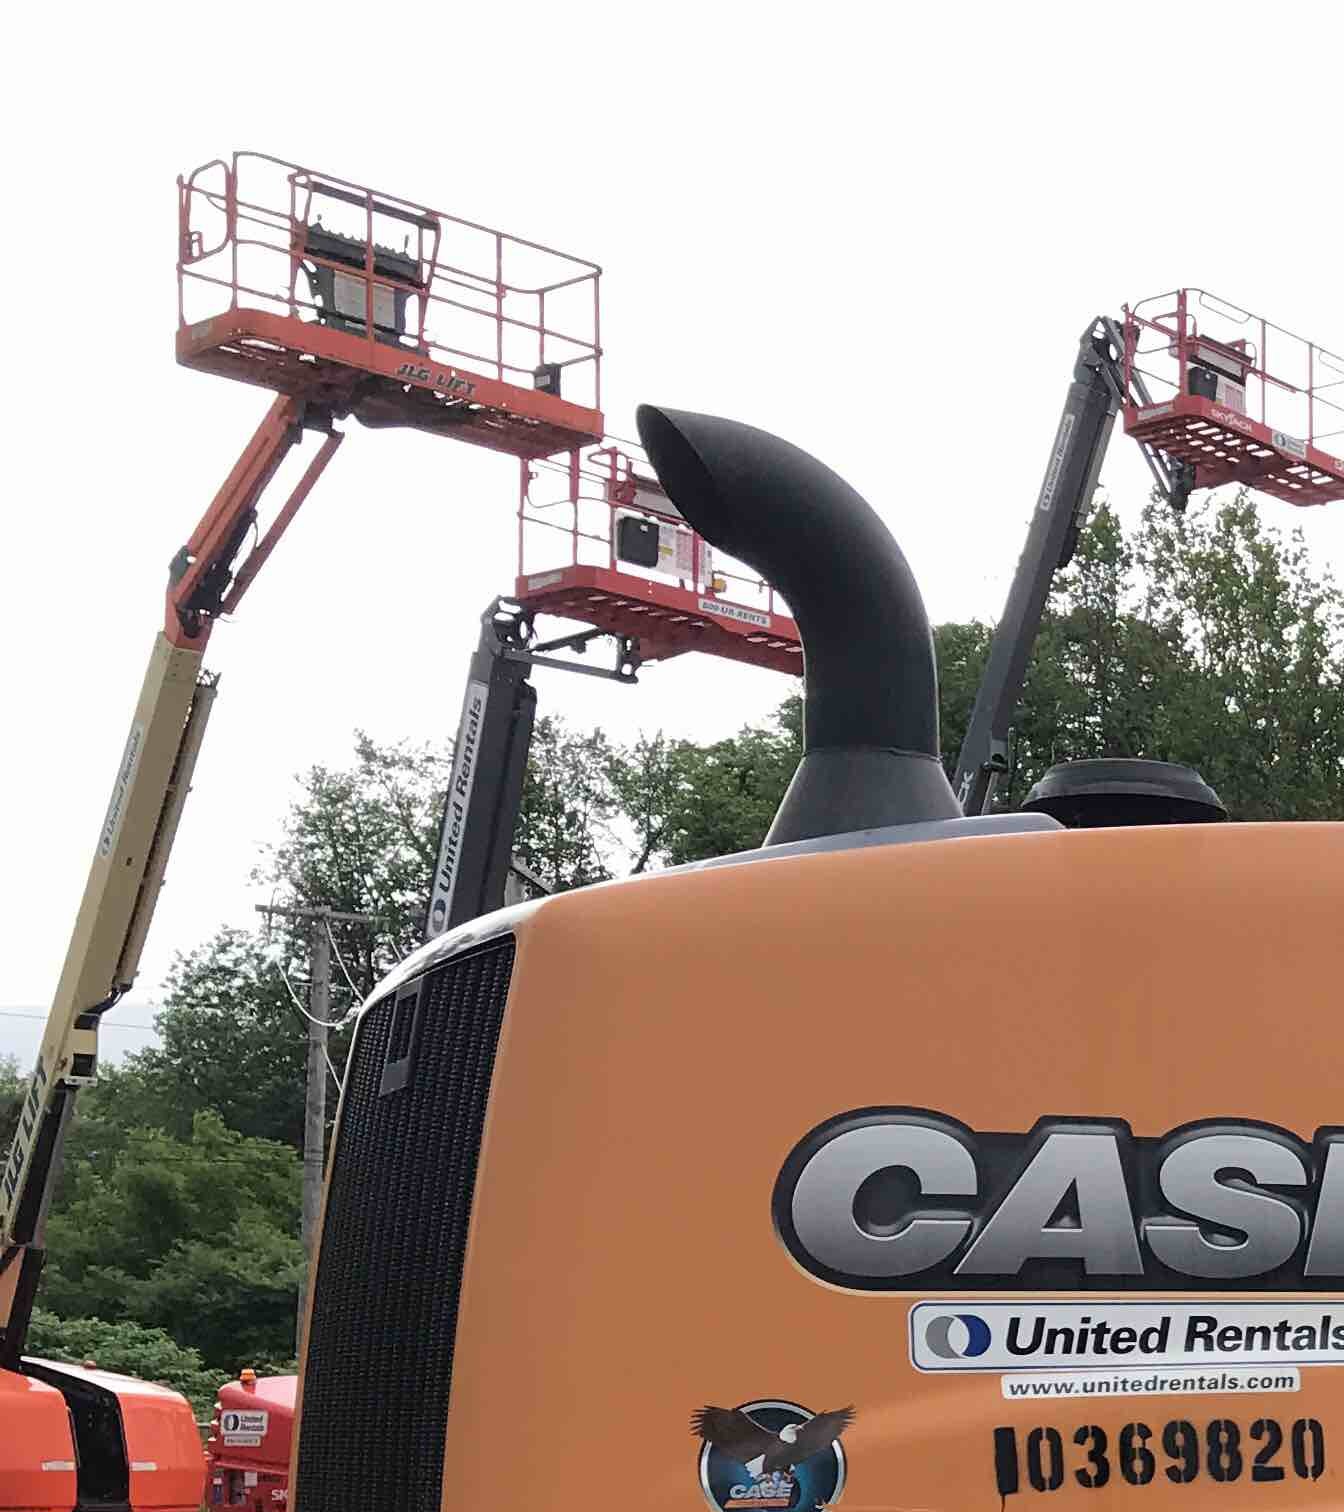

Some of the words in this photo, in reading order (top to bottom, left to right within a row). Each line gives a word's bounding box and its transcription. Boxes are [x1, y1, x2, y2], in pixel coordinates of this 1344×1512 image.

[439, 801, 464, 893] United
[455, 697, 482, 798] Rentals
[1005, 1315, 1171, 1356] United
[1008, 1373, 1296, 1397] www.unitedrentals.com
[993, 1417, 1326, 1495] 10369820
